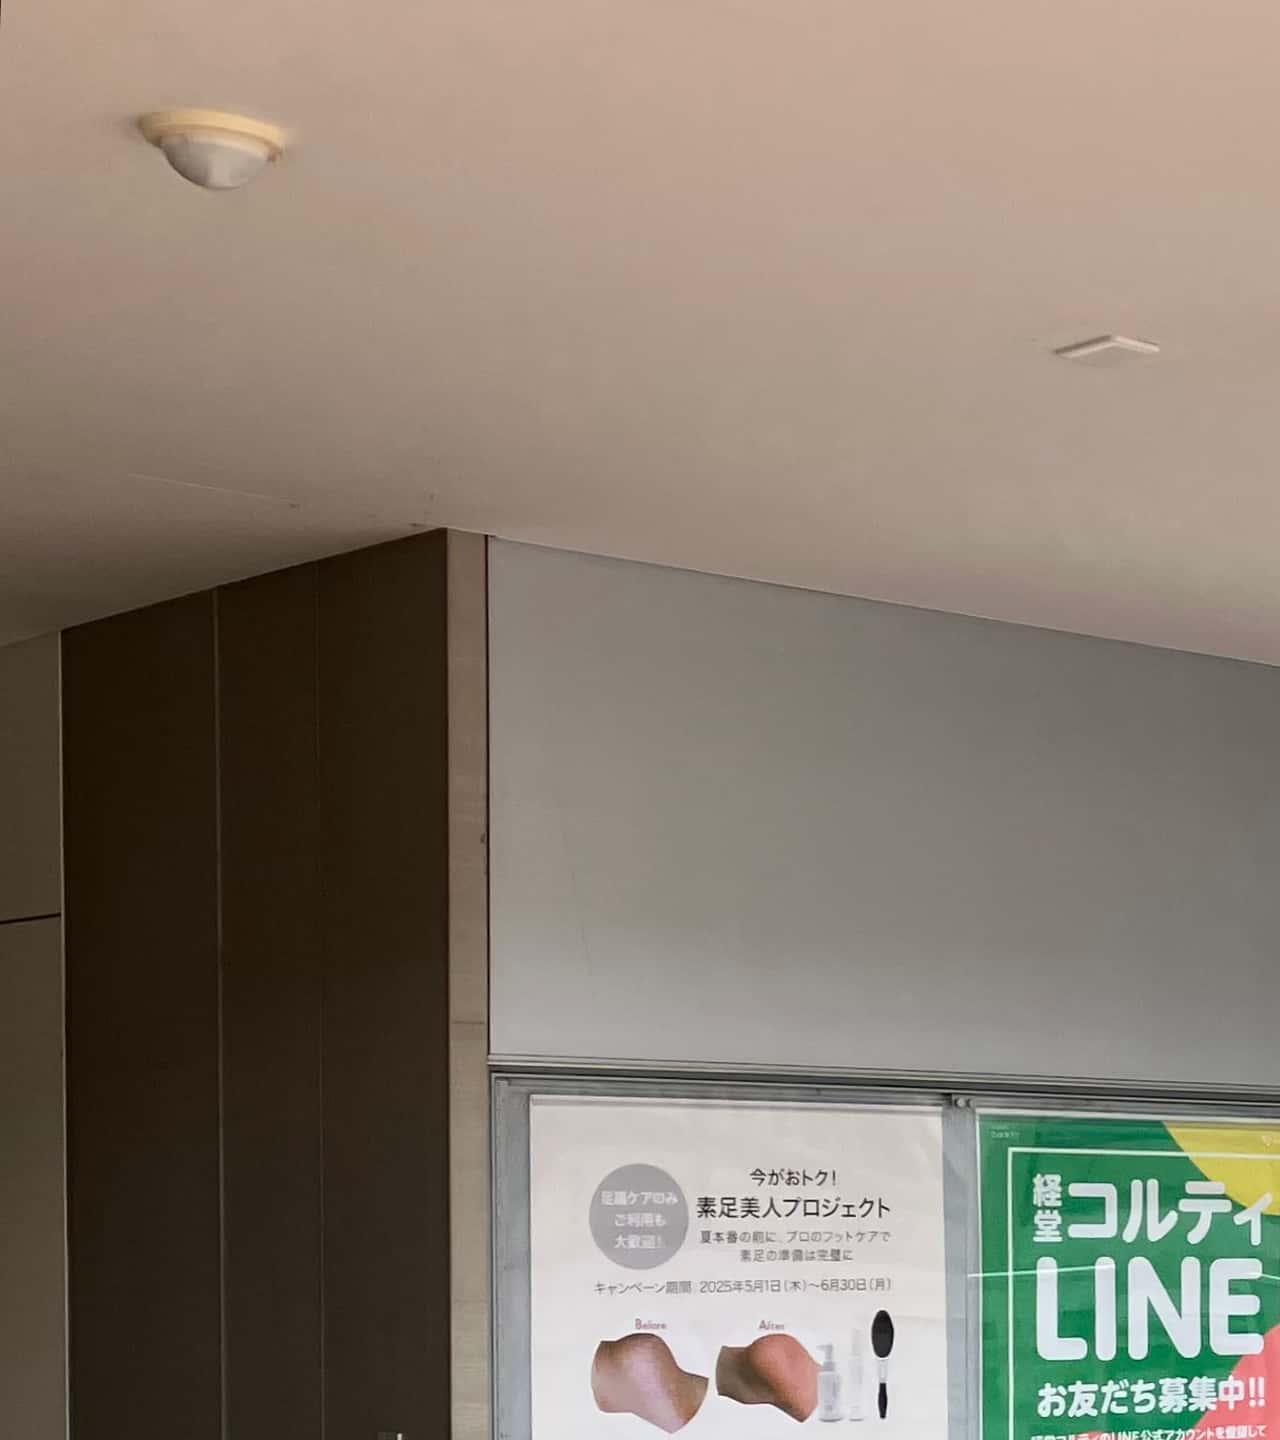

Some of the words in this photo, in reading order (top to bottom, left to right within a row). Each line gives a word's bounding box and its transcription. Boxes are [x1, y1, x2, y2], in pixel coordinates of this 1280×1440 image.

[750, 1168, 838, 1187] 今がおトク!
[696, 1196, 891, 1219] 素足美人プロジェクト
[1033, 1174, 1063, 1243] 経堂
[1068, 1179, 1273, 1246] コルティ
[594, 1281, 692, 1296] キャンペーン期間
[1036, 1256, 1265, 1361] LINE
[1037, 1376, 1266, 1418] お友だち募集中!!
